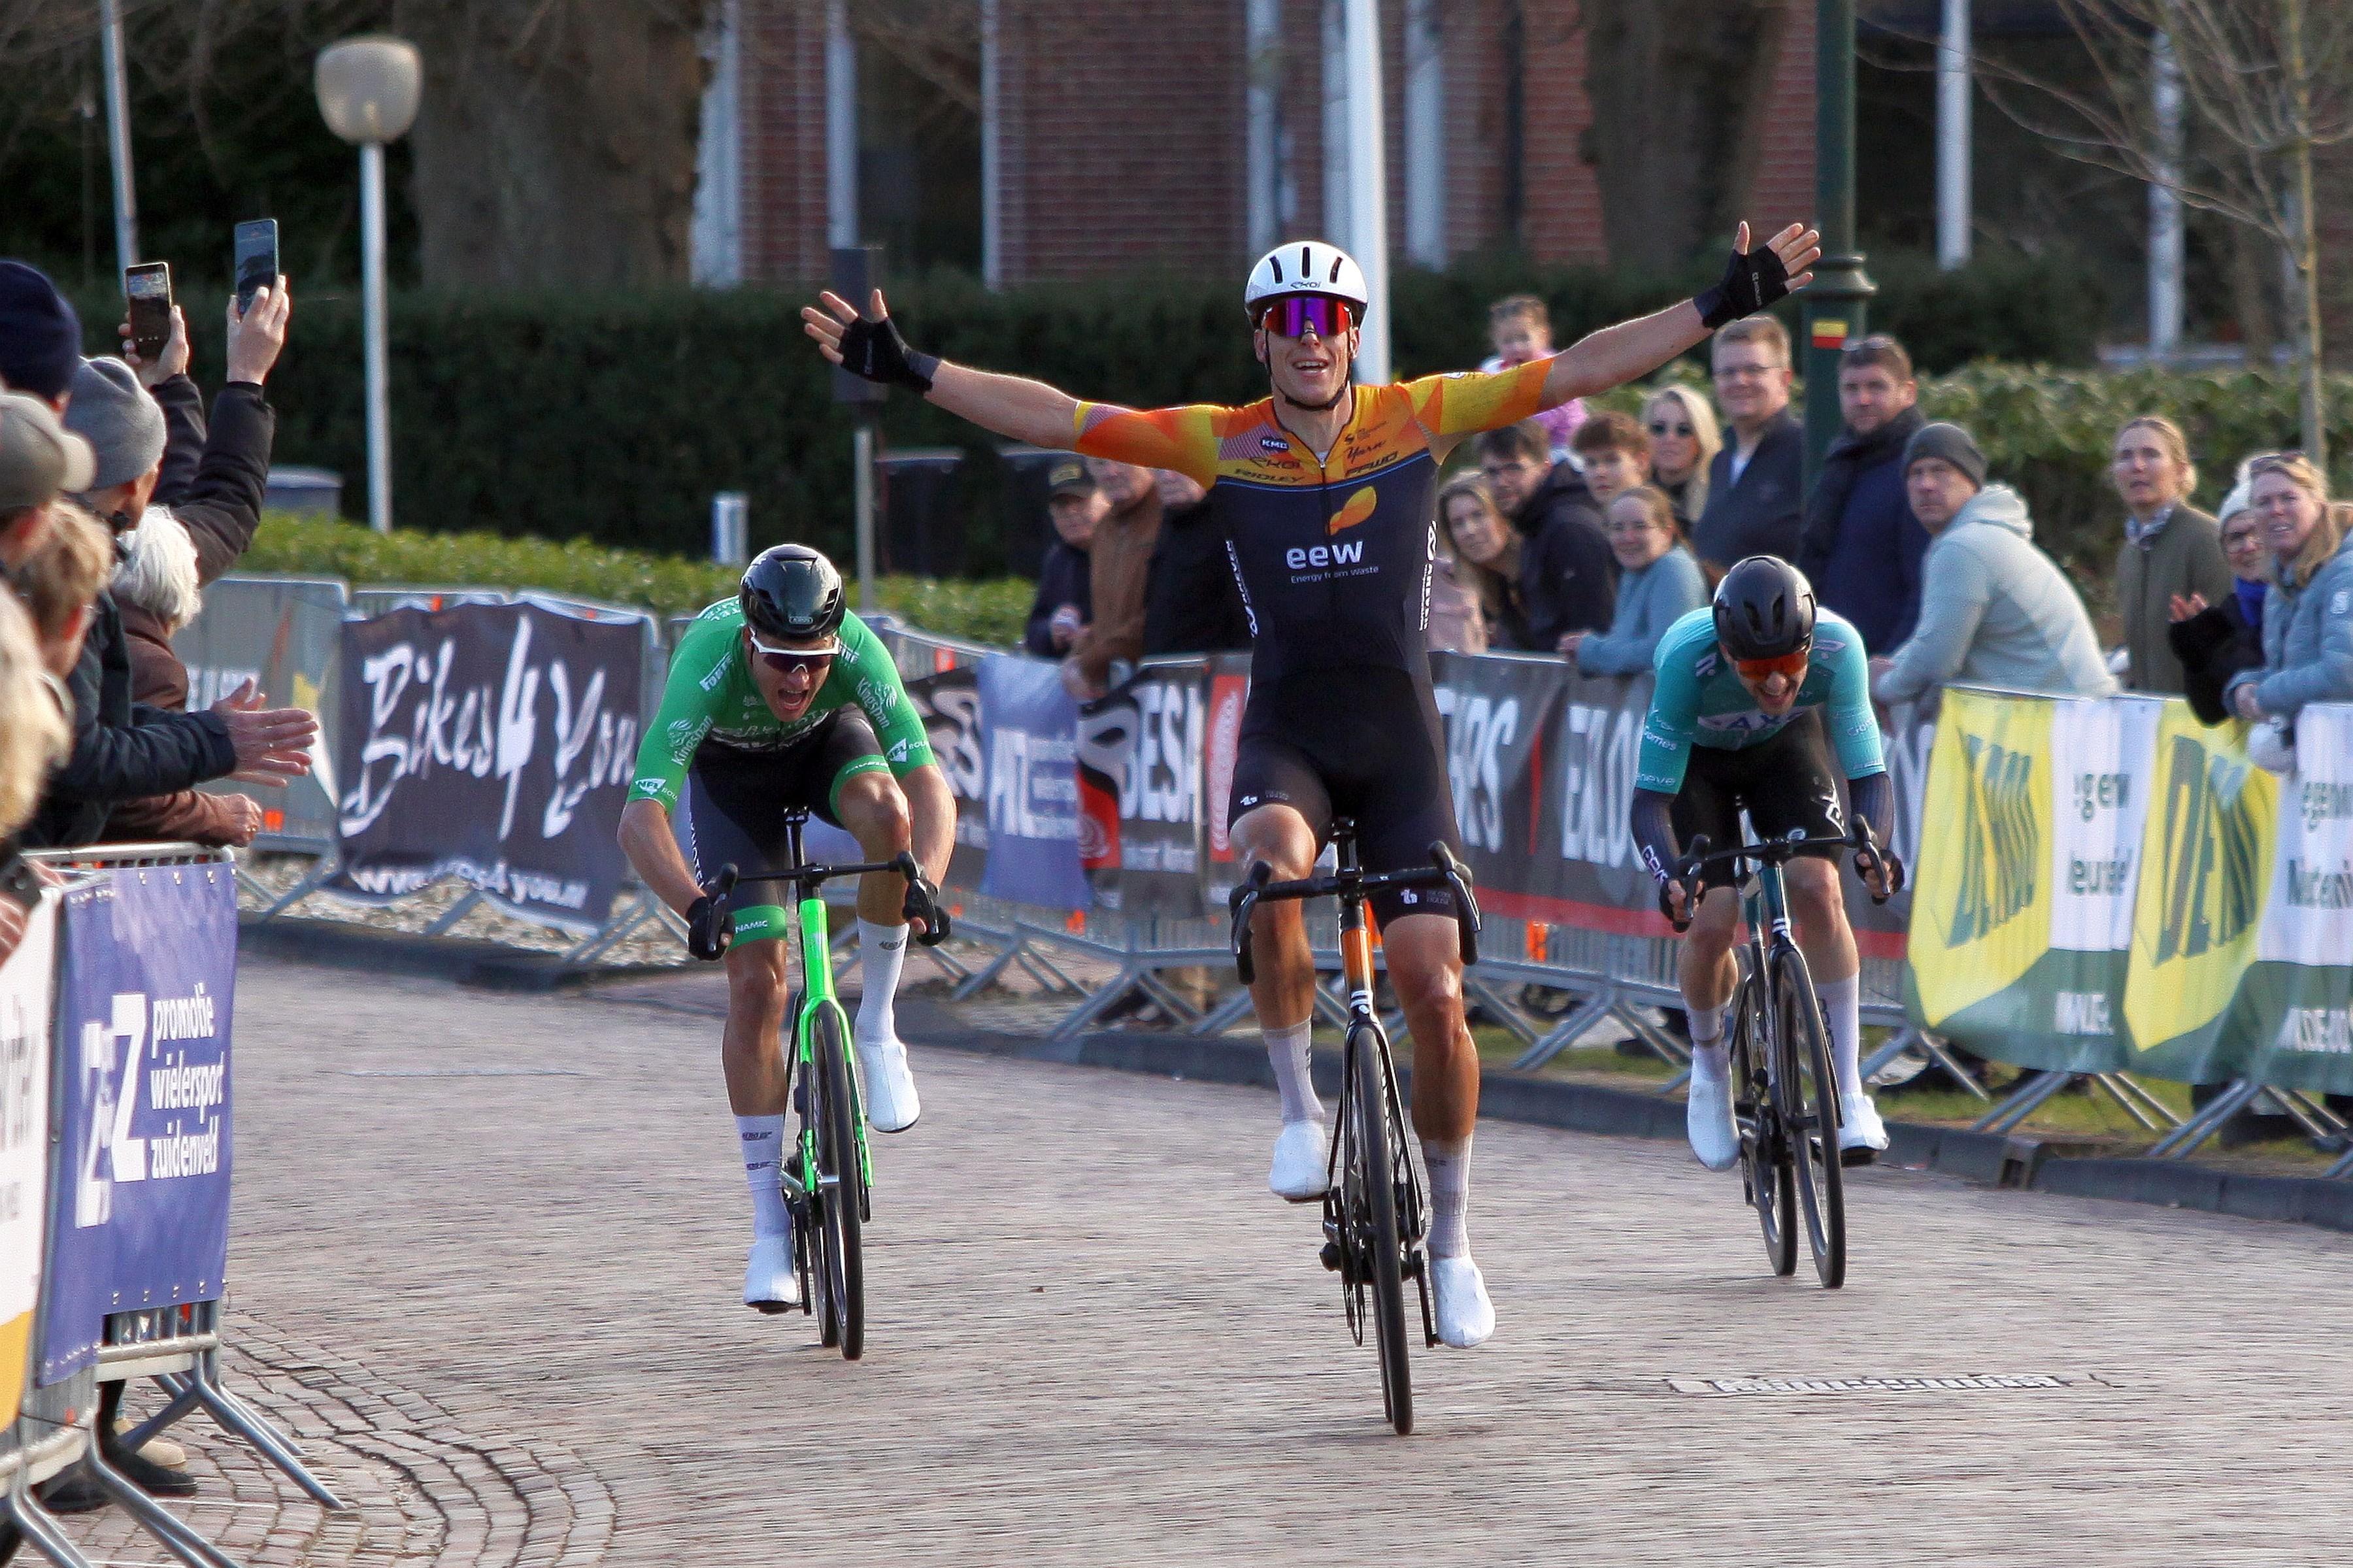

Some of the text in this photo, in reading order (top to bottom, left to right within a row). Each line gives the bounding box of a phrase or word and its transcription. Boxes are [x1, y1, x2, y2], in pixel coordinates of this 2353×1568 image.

[1286, 541, 1363, 570] eew
[1291, 566, 1380, 584] Energy from Waste
[856, 676, 890, 729] Kingspan
[671, 715, 714, 766] Kingspan
[152, 982, 215, 1059] promotie
[150, 1049, 225, 1124] wielersport
[150, 1114, 220, 1179] zuidenveld
